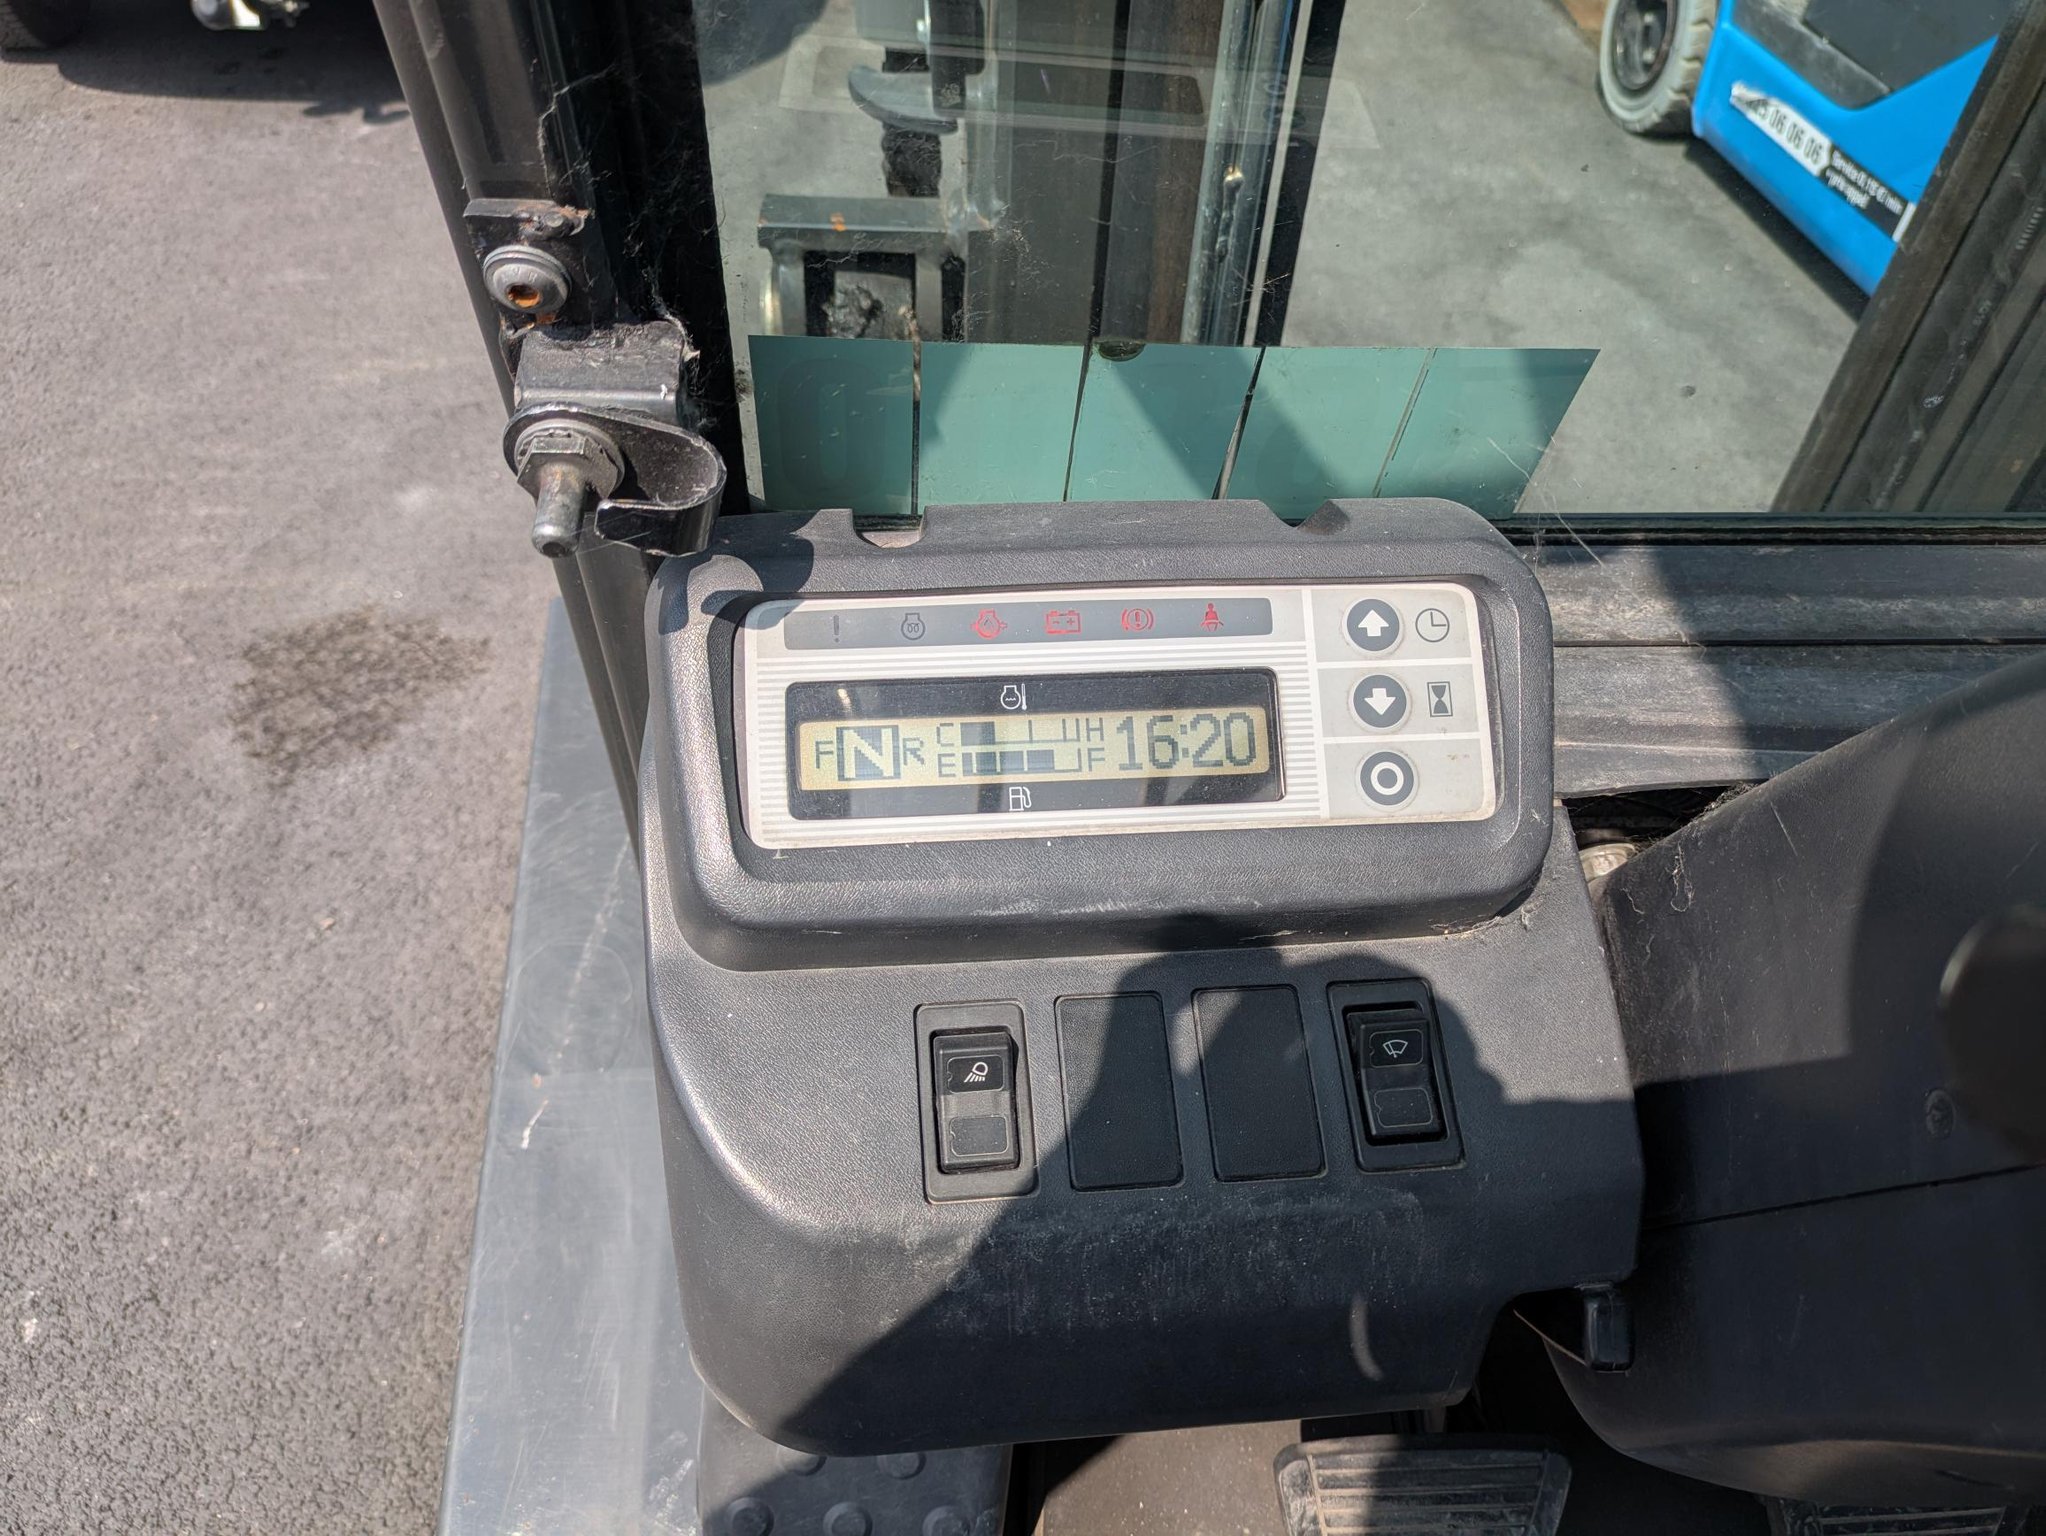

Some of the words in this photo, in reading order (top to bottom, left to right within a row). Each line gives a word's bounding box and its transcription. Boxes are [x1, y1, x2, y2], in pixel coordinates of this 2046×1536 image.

[1769, 108, 1787, 135] 06
[1786, 121, 1805, 151] 06
[1803, 136, 1823, 165] 06
[936, 722, 955, 747] C
[1086, 717, 1105, 742] H
[1116, 711, 1257, 770] 16:20
[815, 740, 834, 769] F
[842, 727, 895, 780] N
[902, 737, 925, 766] R
[937, 753, 957, 778] E
[1086, 747, 1106, 772] F
